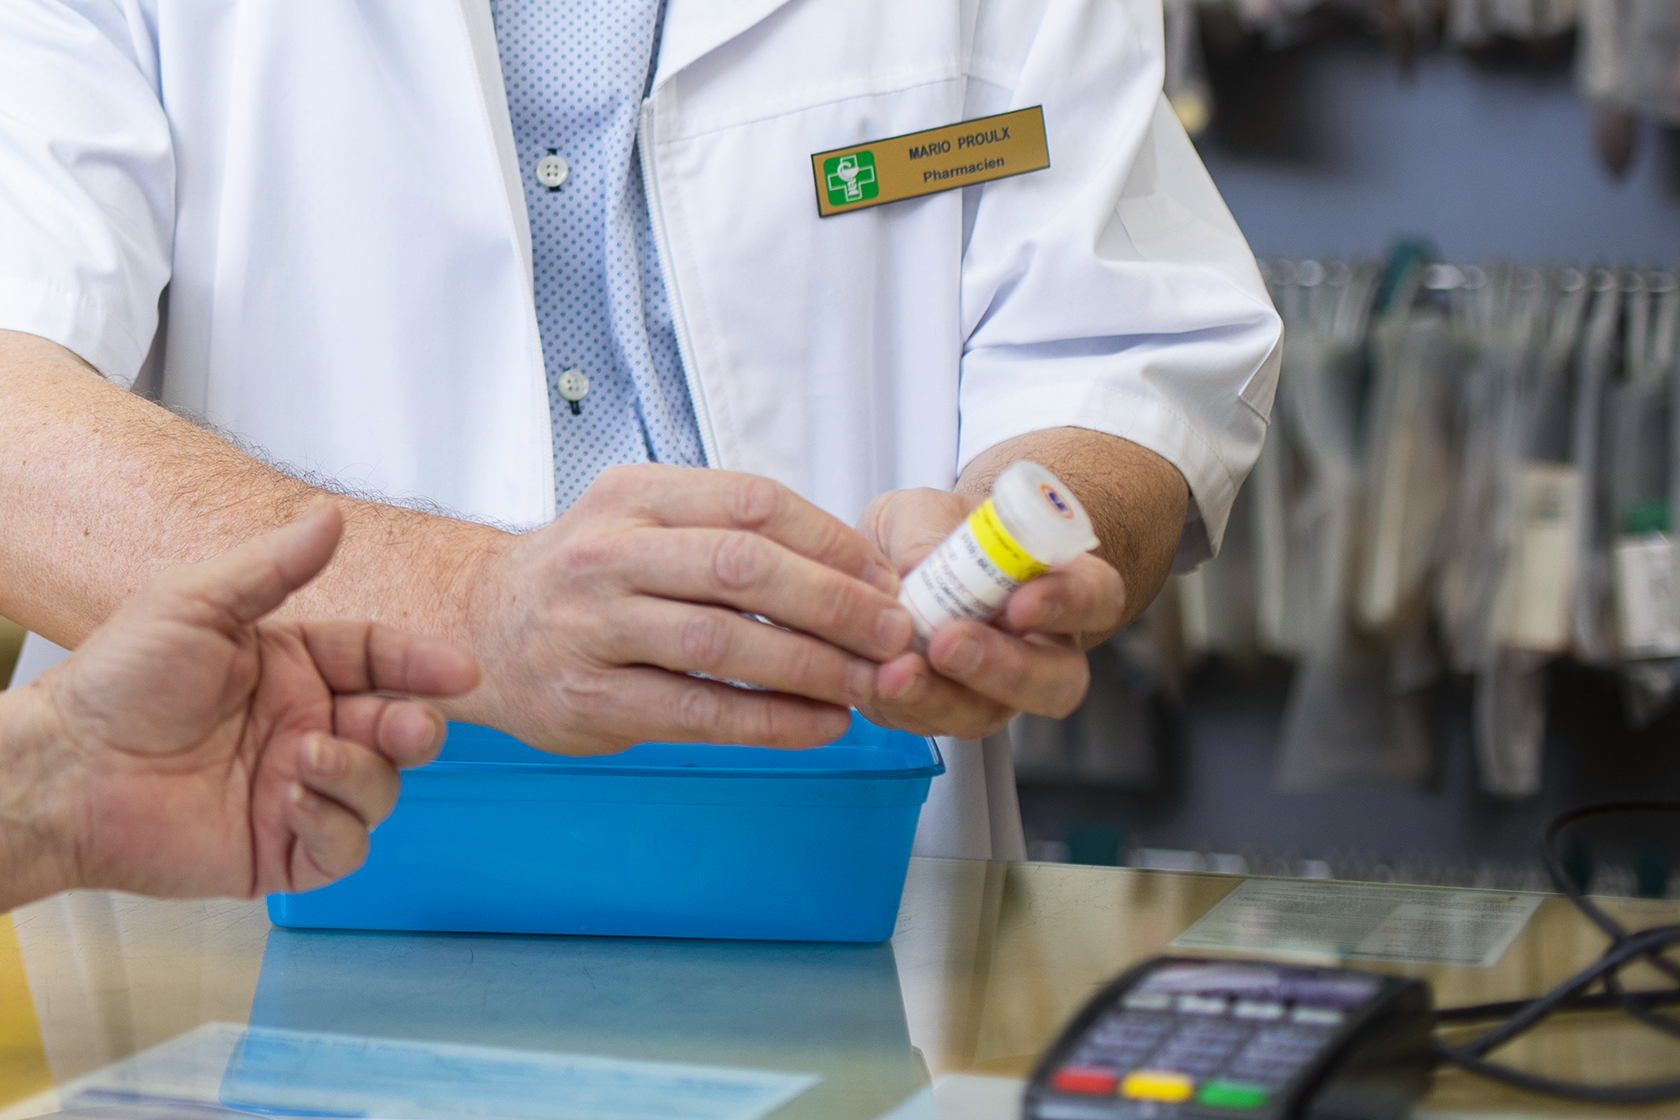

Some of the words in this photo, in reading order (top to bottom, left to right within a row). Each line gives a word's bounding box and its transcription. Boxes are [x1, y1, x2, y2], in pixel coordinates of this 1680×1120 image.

[909, 140, 951, 160] MARIO
[957, 126, 1010, 150] PROULX
[923, 157, 1005, 183] Pharmacien
